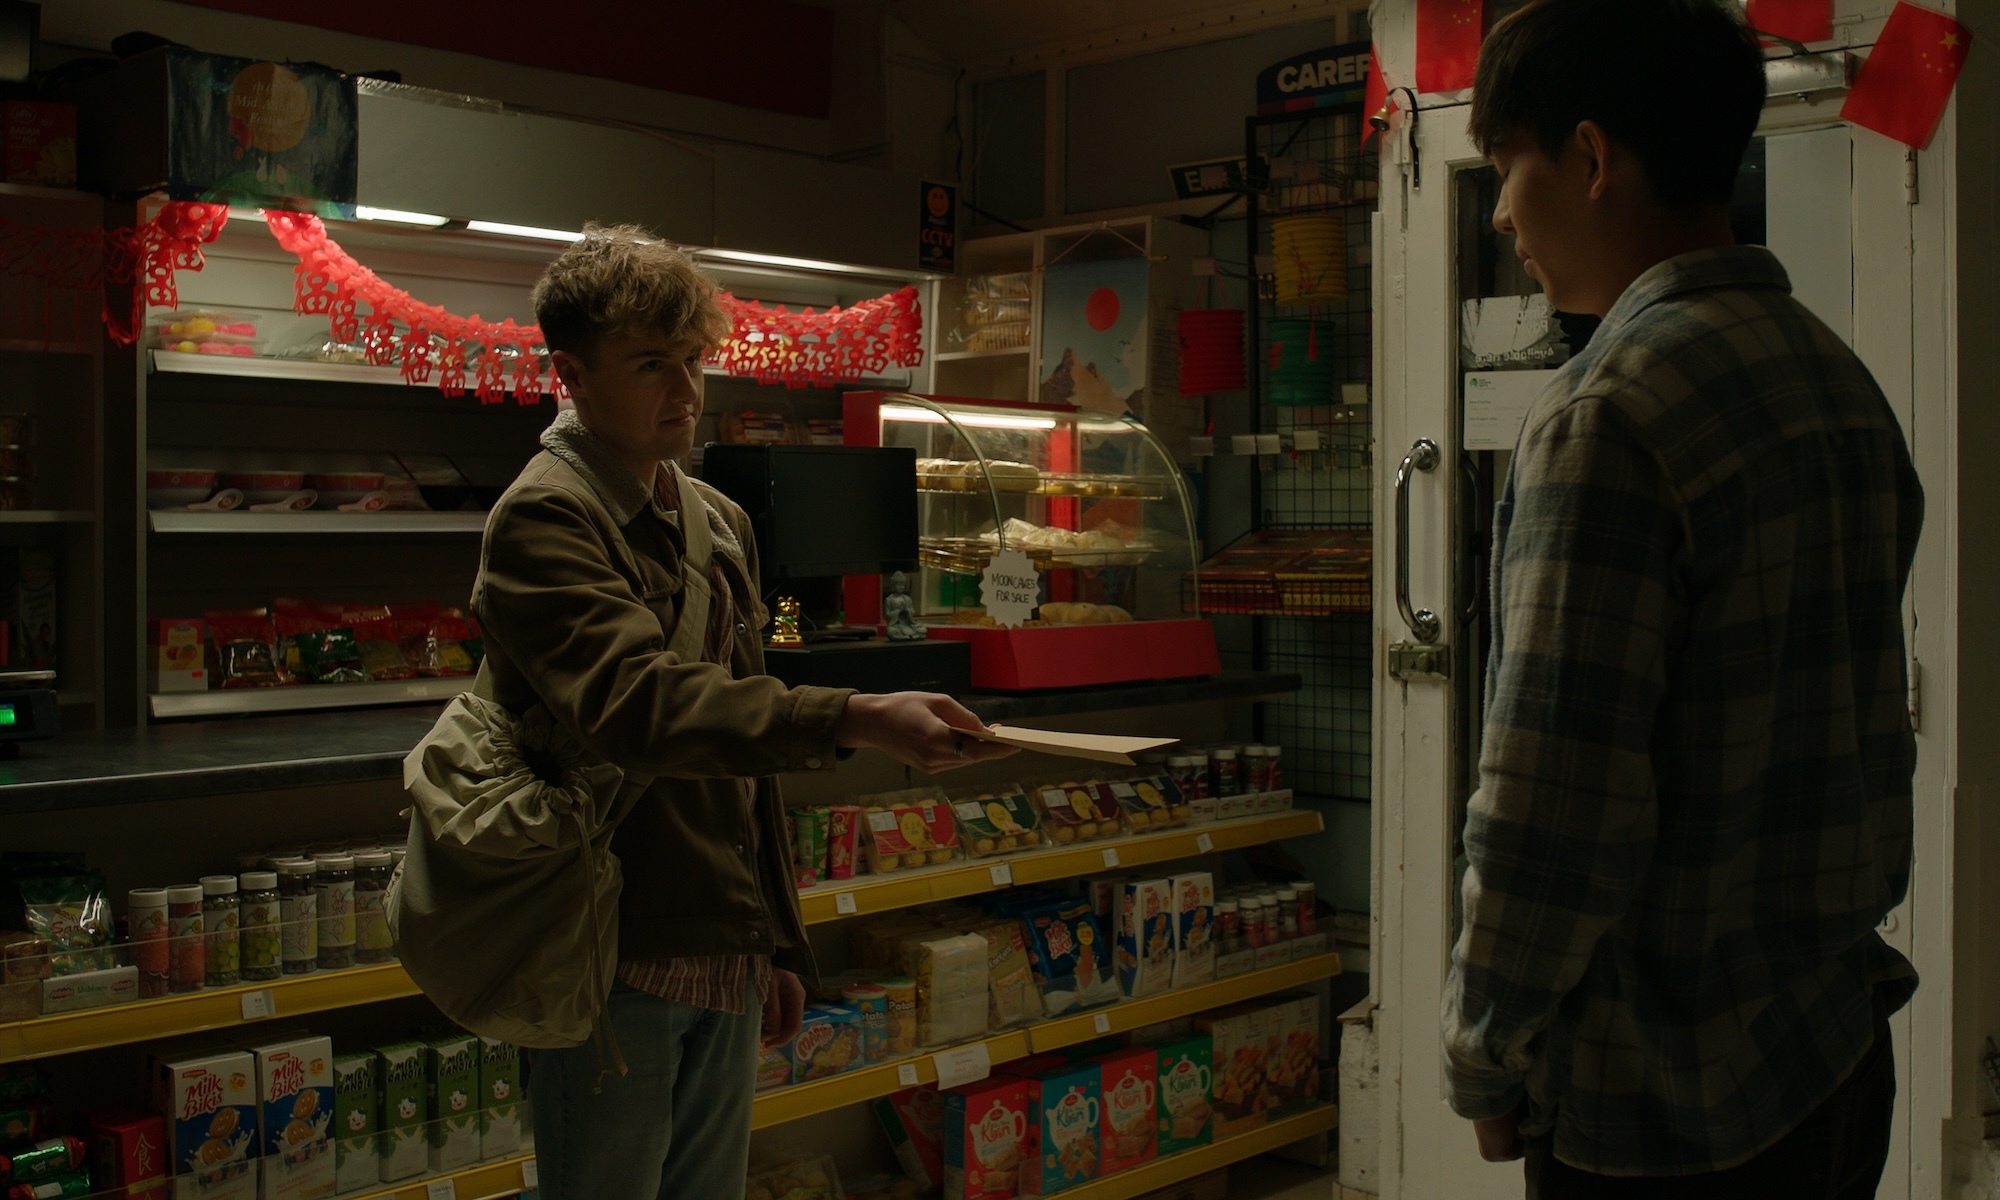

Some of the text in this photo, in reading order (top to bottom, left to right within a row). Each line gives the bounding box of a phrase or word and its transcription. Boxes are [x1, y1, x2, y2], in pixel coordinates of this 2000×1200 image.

[234, 94, 258, 107] Mid
[920, 227, 953, 248] CCTV
[991, 573, 1036, 590] MOONCAKES
[996, 589, 1030, 603] FOR SALE
[483, 1049, 520, 1065] CANDIES
[490, 1043, 513, 1053] MILK
[396, 1058, 419, 1071] MILK
[439, 1058, 478, 1076] CANDIES
[447, 1051, 470, 1065] MILK
[271, 1056, 304, 1085] Milk
[345, 1068, 369, 1083] MILK
[387, 1065, 427, 1083] CANDIES
[185, 1073, 223, 1102] Milk
[270, 1075, 304, 1102] Bikis
[336, 1077, 377, 1095] CANDIES
[183, 1091, 223, 1120] Bikis
[132, 1132, 156, 1176] 食
